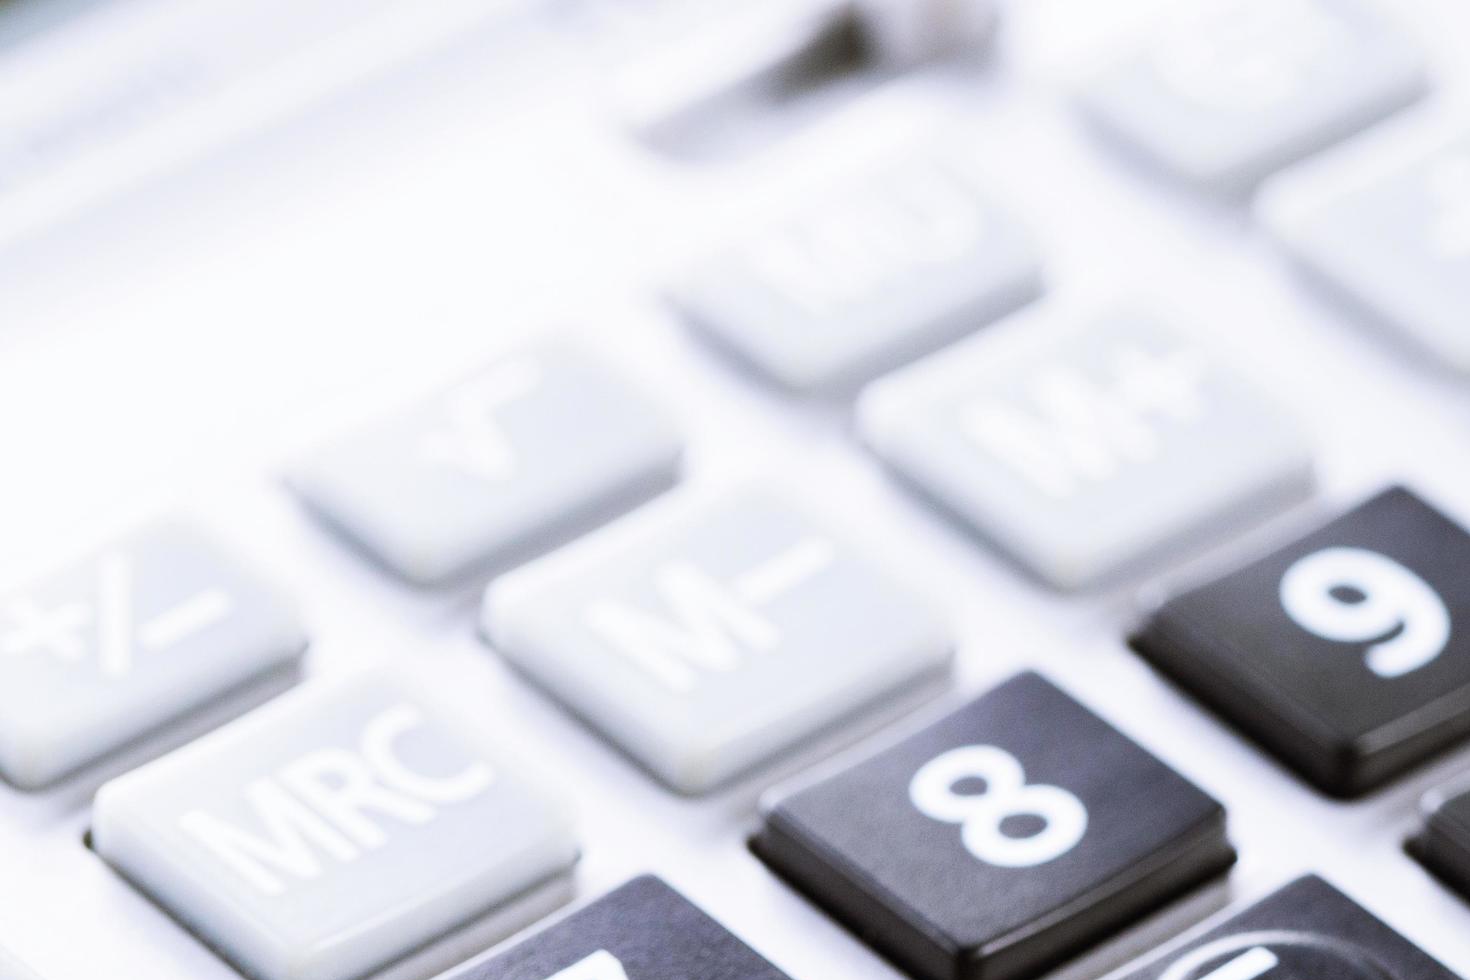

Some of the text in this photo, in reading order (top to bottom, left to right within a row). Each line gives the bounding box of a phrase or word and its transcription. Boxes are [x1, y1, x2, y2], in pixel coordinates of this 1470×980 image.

[1278, 546, 1451, 678] 9
[180, 705, 497, 898] MRC
[909, 743, 1088, 869] 8
